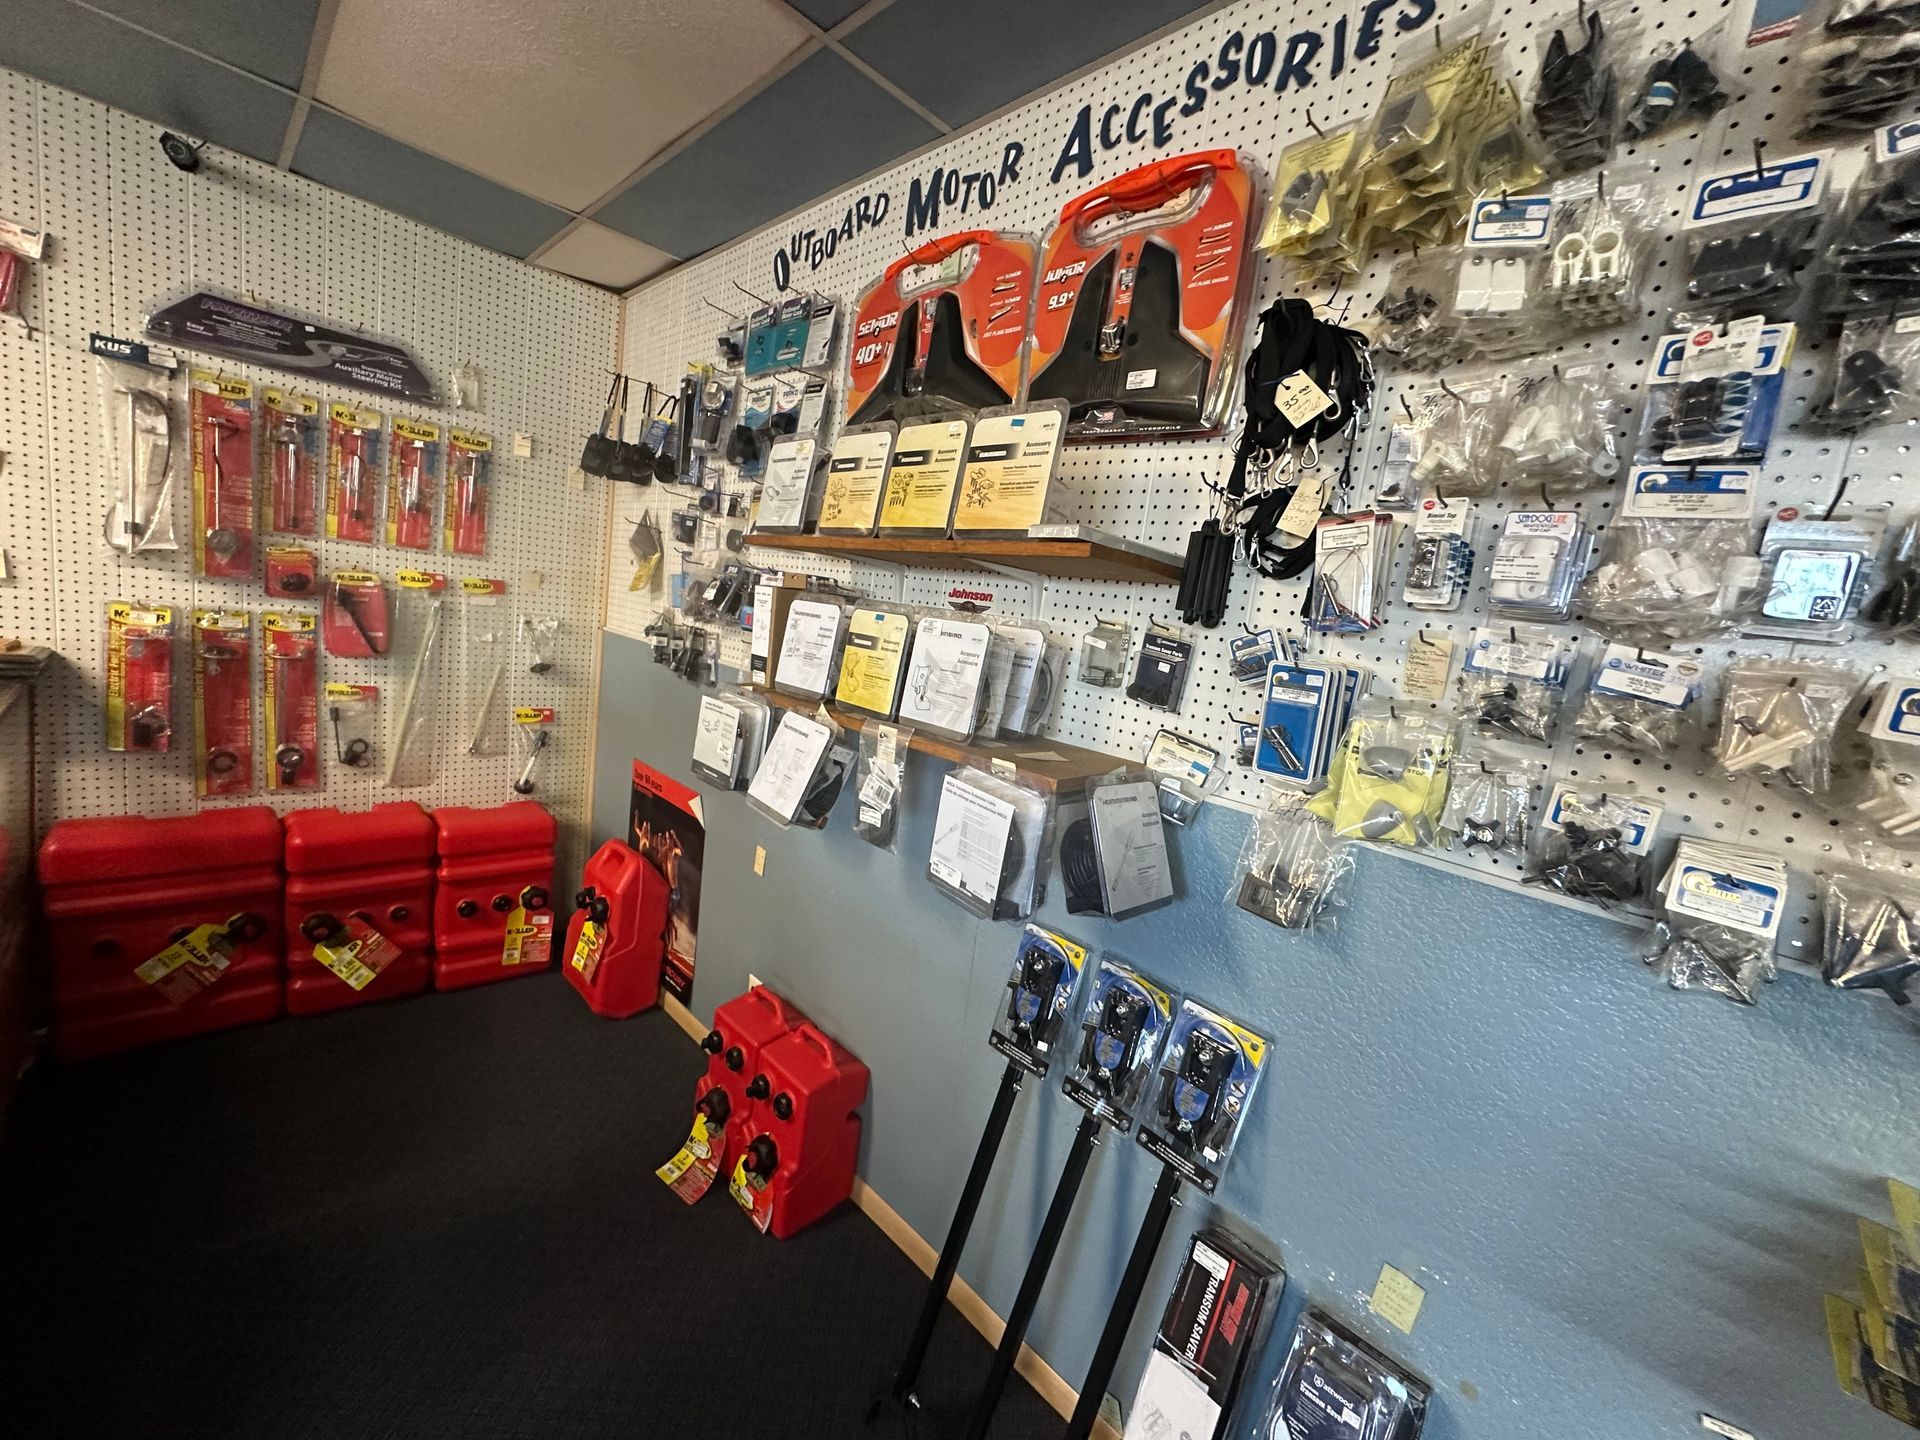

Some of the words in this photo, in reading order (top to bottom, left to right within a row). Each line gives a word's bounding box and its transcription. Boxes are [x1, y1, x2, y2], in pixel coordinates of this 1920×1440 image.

[774, 192, 889, 292] OUTBOARD
[905, 141, 1023, 237] MOTOR
[1051, 0, 1436, 184] ACCESSORIES
[1044, 261, 1086, 283] JUNIOR
[857, 311, 899, 337] SENIOR
[94, 339, 132, 355] KUS
[334, 362, 375, 378] Auxiliary
[376, 372, 402, 384] Motor
[352, 371, 388, 388] Steering
[389, 382, 402, 390] Kit
[948, 588, 995, 602] Johnson
[1196, 1277, 1220, 1327] TRANSOM
[1184, 1322, 1204, 1361] SAVER
[1300, 1383, 1326, 1410] Transom
[1322, 1383, 1354, 1410] attwood
